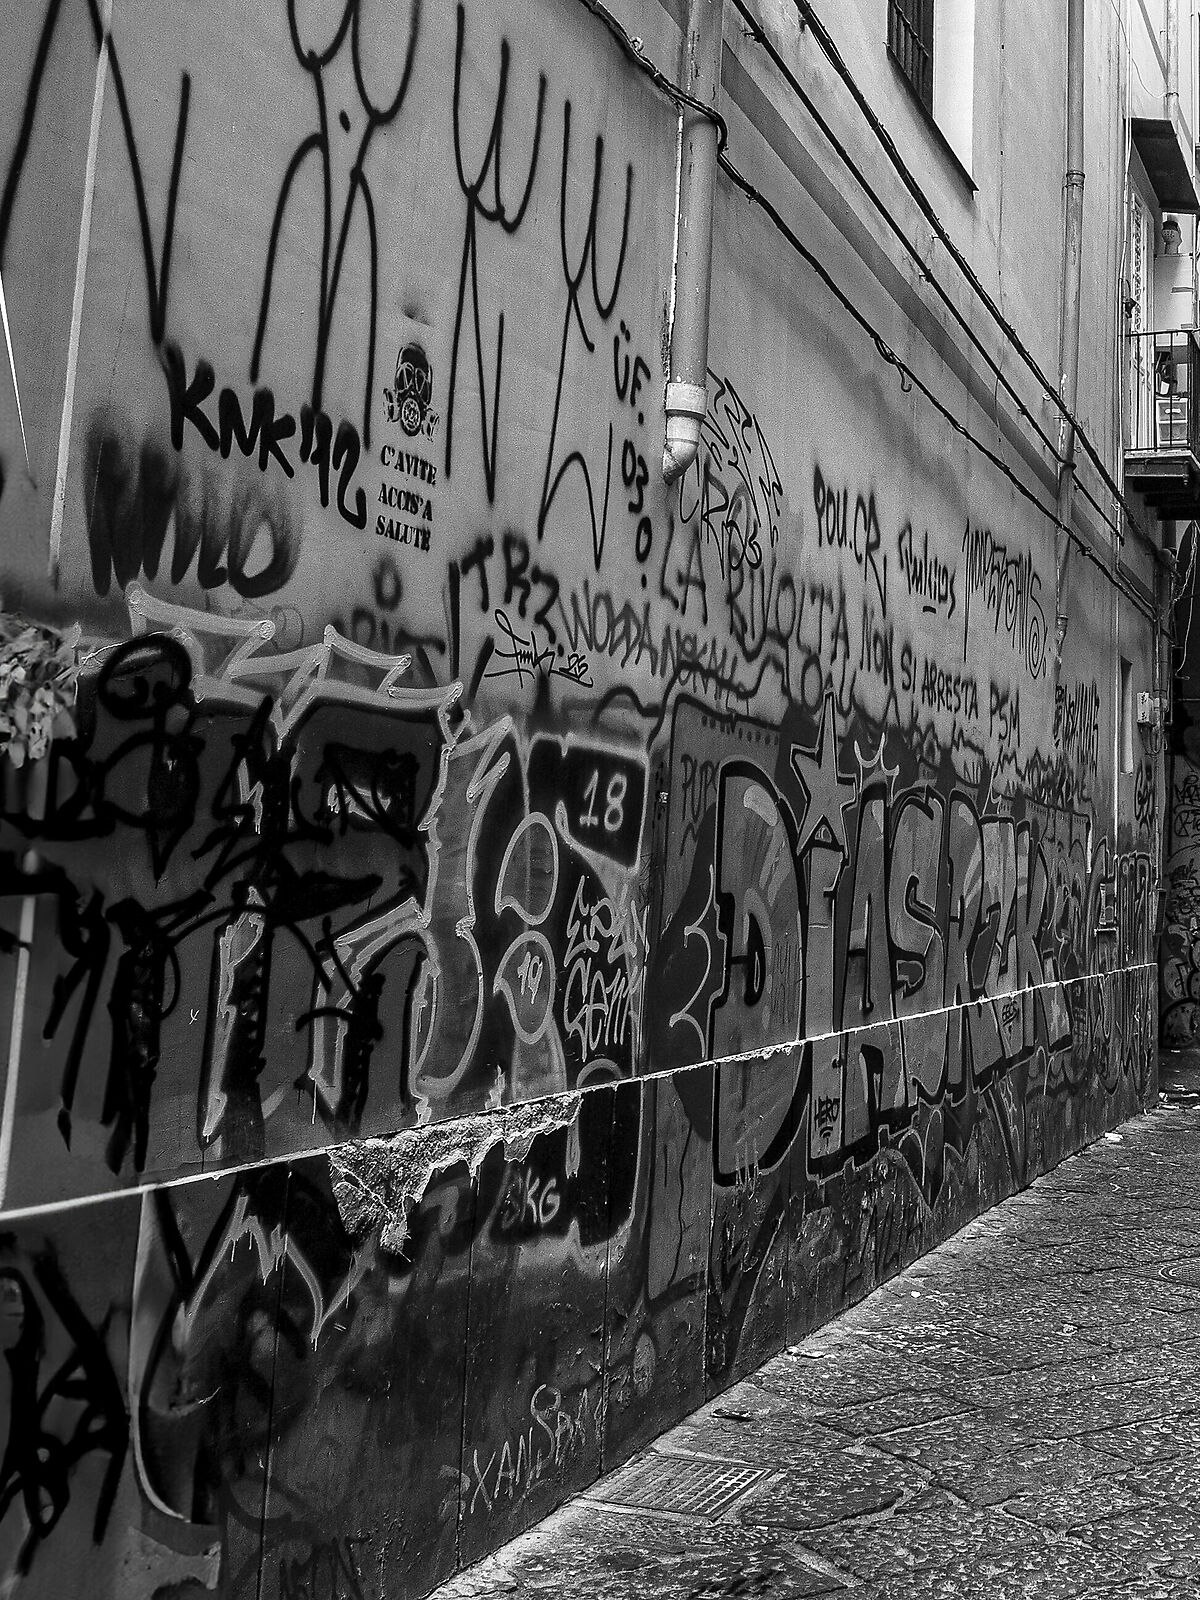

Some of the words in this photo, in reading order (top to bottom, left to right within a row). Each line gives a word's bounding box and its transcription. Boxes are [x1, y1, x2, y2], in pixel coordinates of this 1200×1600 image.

[375, 514, 431, 552] SALUTE
[660, 515, 708, 626] LA
[860, 600, 895, 692] NON
[900, 641, 917, 695] SI
[922, 656, 979, 721] ARRESTA
[579, 769, 628, 832] 18
